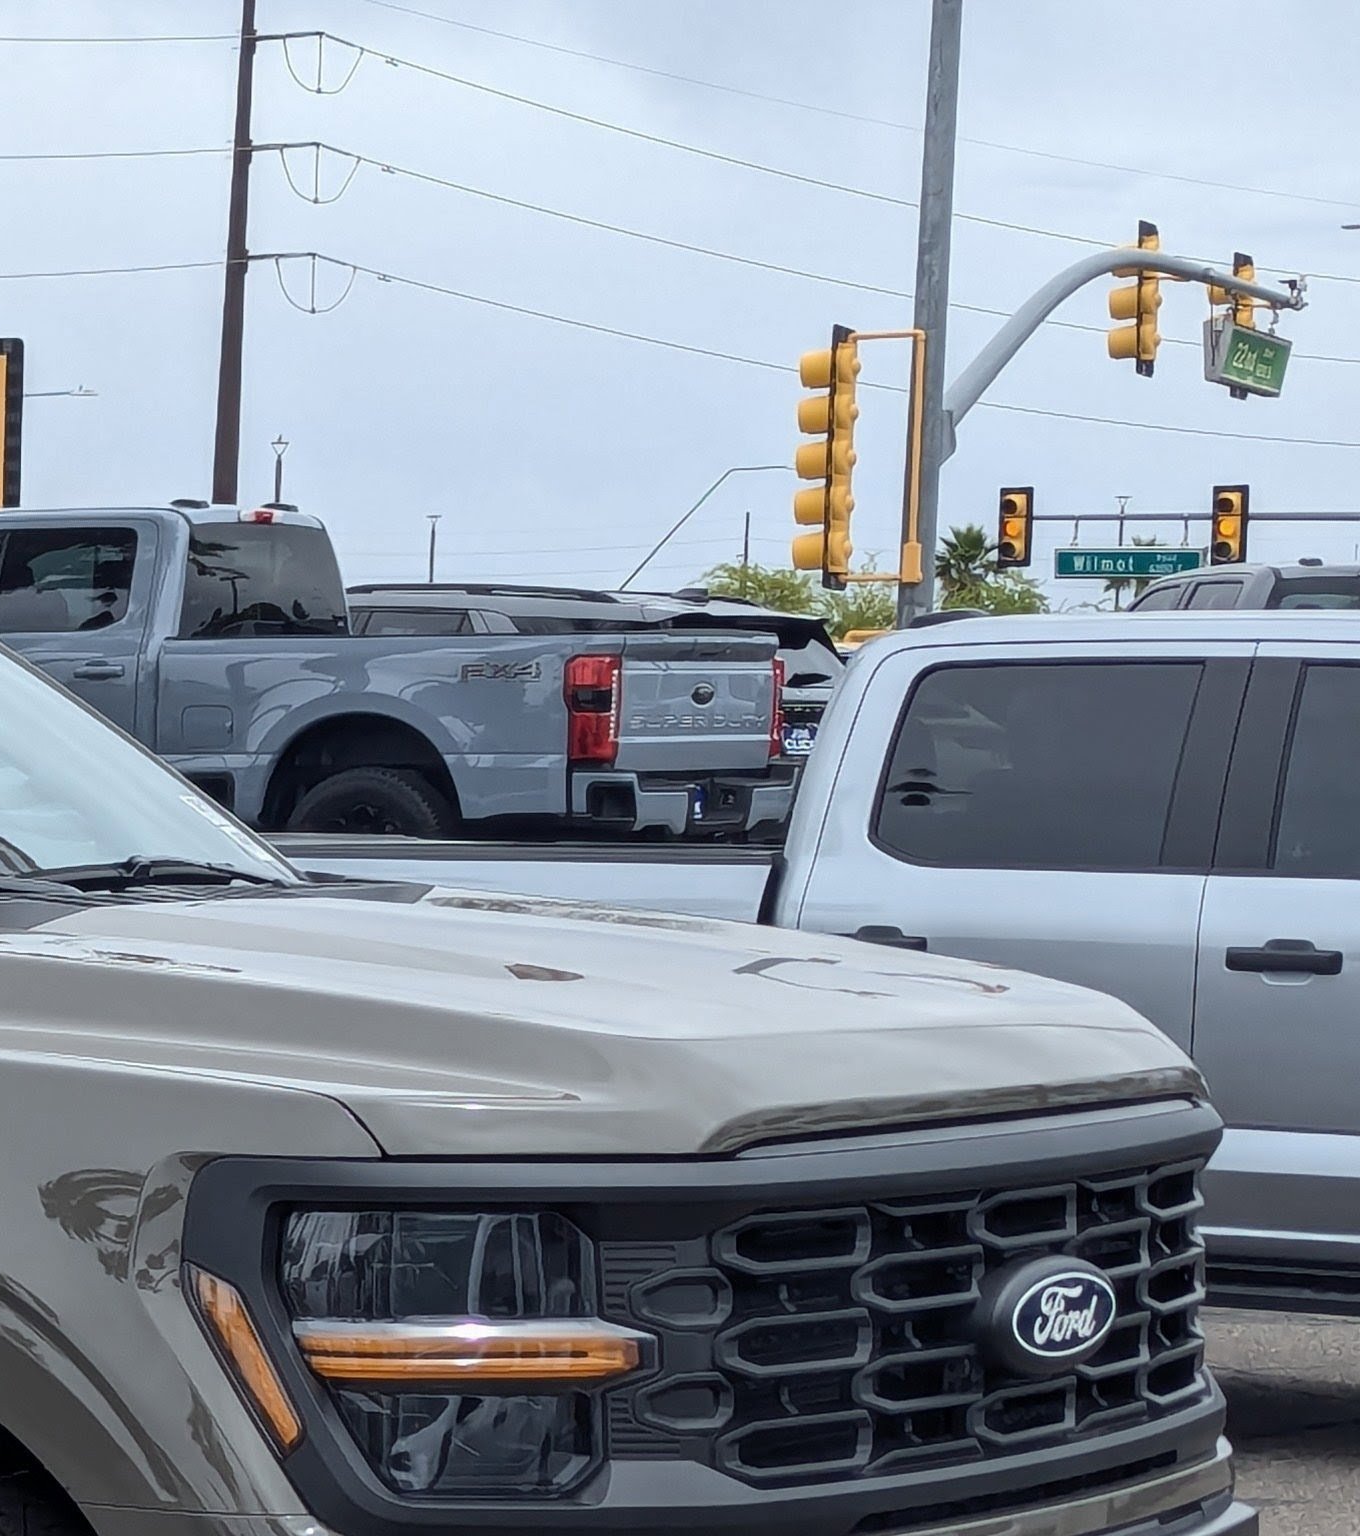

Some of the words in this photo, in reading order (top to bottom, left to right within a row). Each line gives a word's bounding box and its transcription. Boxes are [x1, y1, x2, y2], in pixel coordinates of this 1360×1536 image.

[1073, 555, 1134, 572] Wilmot
[460, 662, 542, 682] FX4
[629, 715, 709, 729] SUPER
[713, 714, 767, 728] DUTY
[1033, 1285, 1098, 1346] Ford
